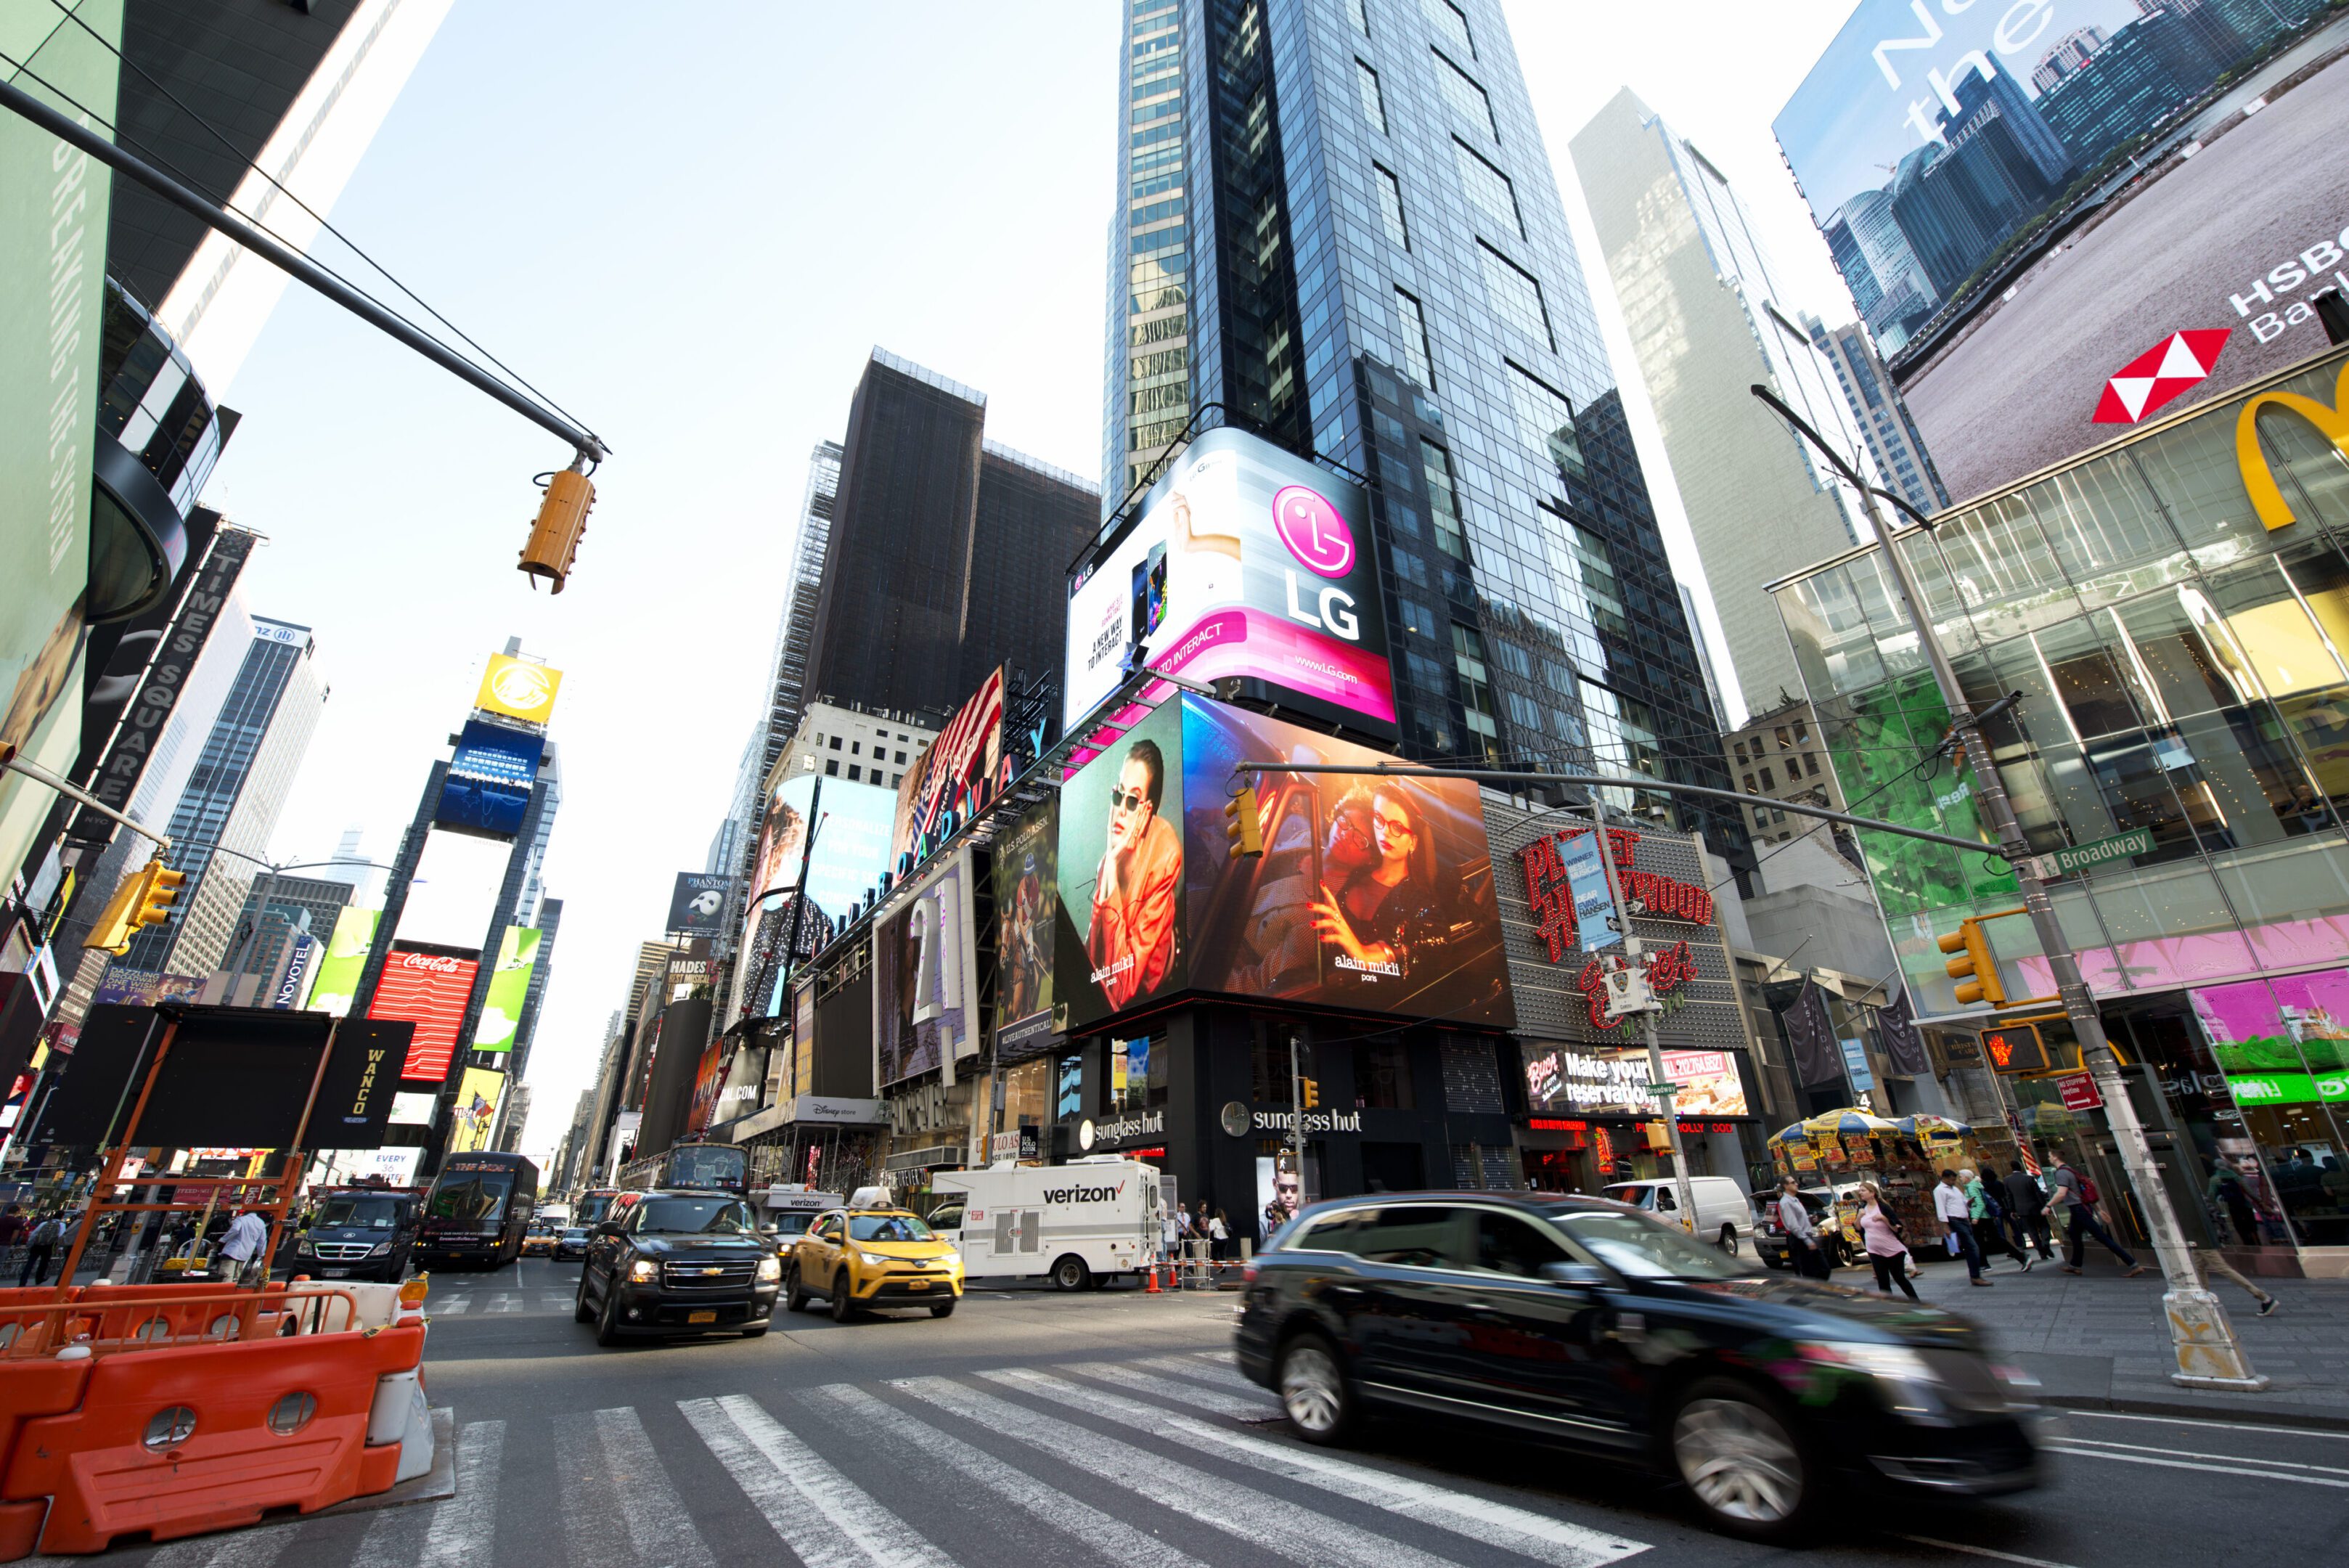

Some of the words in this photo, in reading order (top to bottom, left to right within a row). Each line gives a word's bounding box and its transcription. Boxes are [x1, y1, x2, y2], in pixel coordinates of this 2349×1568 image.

[1902, 0, 2054, 142] the
[50, 364, 81, 462] THE
[49, 444, 77, 576] SYSTEM
[1082, 563, 1093, 582] LG
[172, 553, 240, 653] TIMES
[1285, 568, 1360, 640] LG
[1092, 641, 1096, 654] A
[1097, 629, 1109, 650] NEW
[1110, 615, 1122, 637] WAY
[1088, 658, 1095, 671] TO
[1096, 629, 1122, 664] INTERACT
[1161, 658, 1172, 673] TO
[1173, 622, 1223, 665] INTERACT
[1295, 654, 1358, 685] www.LG.com
[98, 664, 181, 803] SQUARE
[84, 815, 110, 825] NYC
[1016, 829, 1031, 848] POLO
[1031, 815, 1049, 836] ASSN.
[1566, 851, 1594, 867] WINNER
[2060, 833, 2147, 869] Broadway
[1513, 828, 1641, 911] PLET
[1568, 861, 1587, 872] BEST
[1571, 863, 1601, 880] MUSICAL
[687, 877, 732, 887] PHANTOM
[1576, 889, 1598, 902] DEAR
[1577, 899, 1598, 910] EVAN
[1578, 900, 1610, 918] HANSEN
[1626, 902, 1640, 912] WAY
[403, 952, 462, 973] Coca-Cola
[1090, 965, 1111, 984] alain
[1111, 953, 1135, 975] mikli
[1335, 955, 1367, 971] alain
[1368, 961, 1400, 976] mikli
[108, 973, 158, 984] BROADWAY
[110, 967, 160, 980] DAZZLING
[277, 944, 311, 1004] NOVOTEL
[668, 973, 684, 984] BEST
[684, 973, 710, 984] MUSICAL
[1106, 976, 1118, 988] paris
[1361, 974, 1378, 983] paris
[106, 978, 128, 987] ONE
[131, 981, 157, 989] WISH
[1002, 1018, 1052, 1045] #LIVEAUTHENTICALL
[1565, 1052, 1609, 1079] Make
[1609, 1061, 1649, 1085] your
[353, 1049, 385, 1114] WANCO
[1646, 1085, 1676, 1095] Broadway
[2065, 1076, 2087, 1087] STOPPING
[1860, 1093, 1871, 1107] 4
[2062, 1087, 2080, 1096] Anytime
[812, 1103, 841, 1118] Disney
[1331, 1108, 1363, 1132] hut
[1095, 1115, 1143, 1145] sunglass
[1142, 1111, 1164, 1134] hut
[381, 1164, 394, 1172] 36
[455, 1163, 476, 1172] THE
[478, 1163, 507, 1172] RIDE
[791, 1199, 820, 1207] verizon
[1043, 1184, 1116, 1204] verizon
